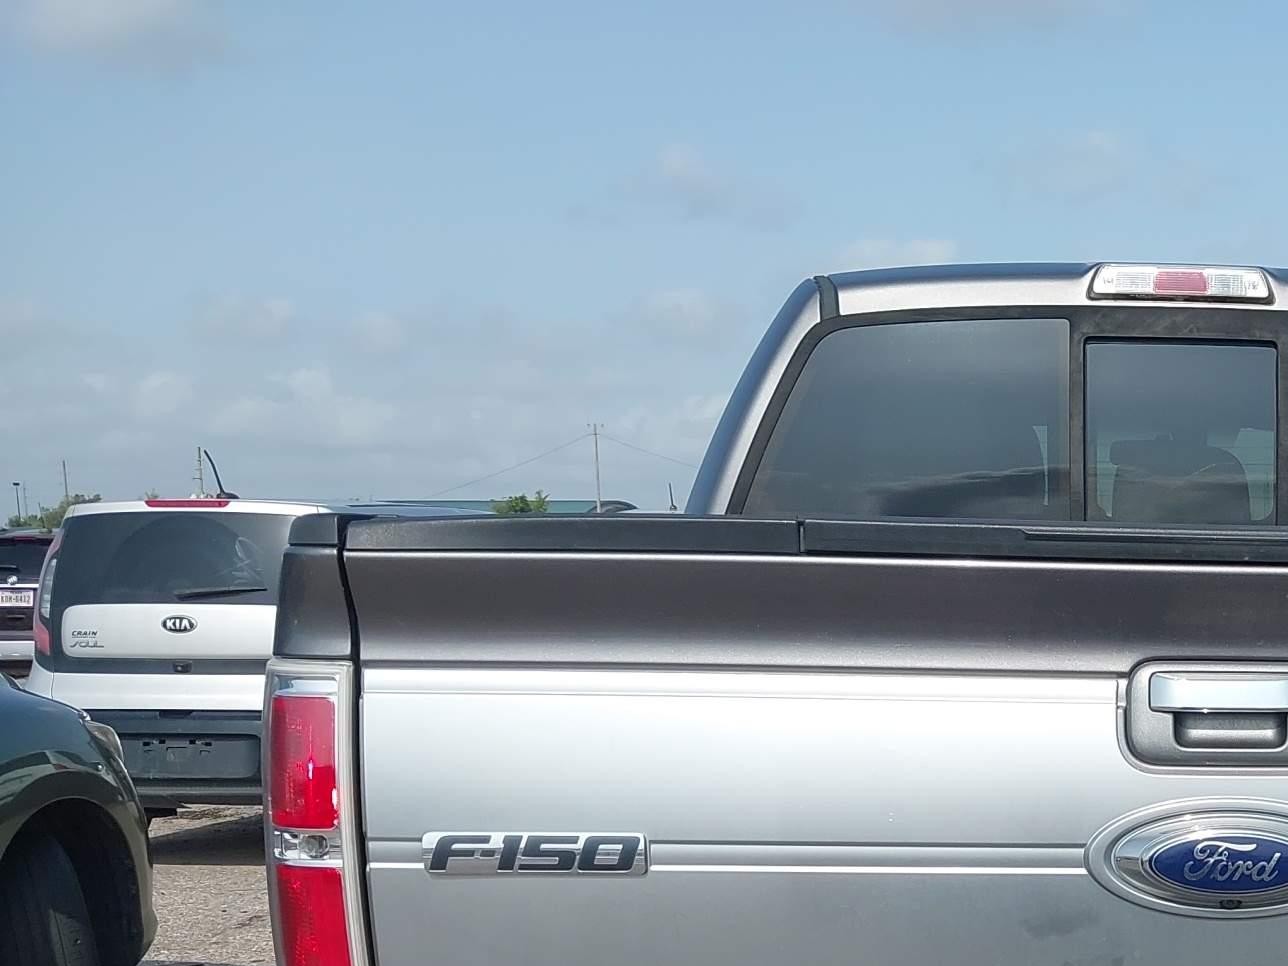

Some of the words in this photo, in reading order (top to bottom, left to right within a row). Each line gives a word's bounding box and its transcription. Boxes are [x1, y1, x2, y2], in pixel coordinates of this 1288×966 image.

[166, 618, 191, 630] KIA
[429, 834, 642, 872] F-150
[1183, 840, 1281, 882] Ford
